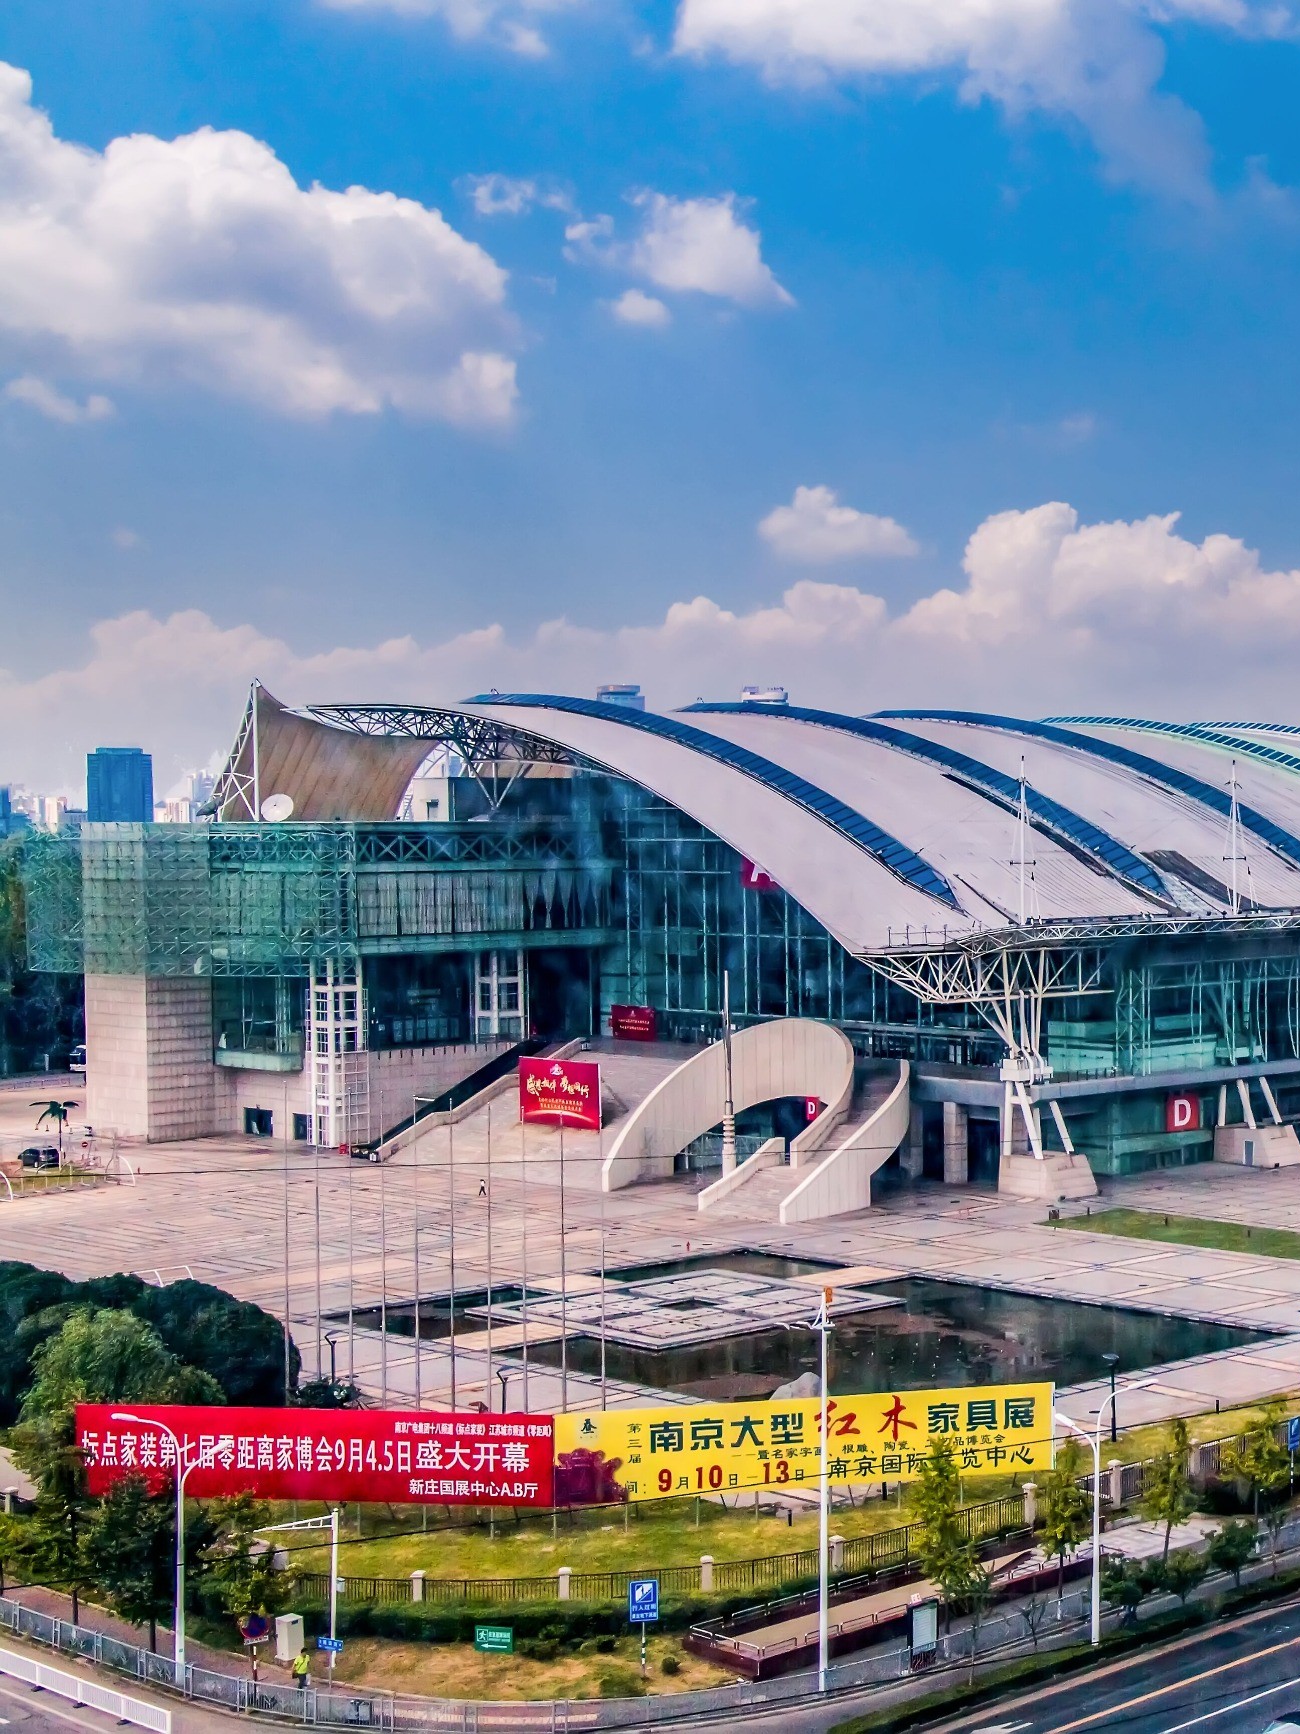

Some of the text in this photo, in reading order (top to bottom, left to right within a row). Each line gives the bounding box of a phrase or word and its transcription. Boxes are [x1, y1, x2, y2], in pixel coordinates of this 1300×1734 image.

[807, 1101, 816, 1115] D
[1174, 1099, 1192, 1127] D
[626, 1422, 643, 1464] 第三届
[827, 1445, 1035, 1479] 南京国际览中心
[408, 1478, 539, 1498] 新庄国展中心A.B厅
